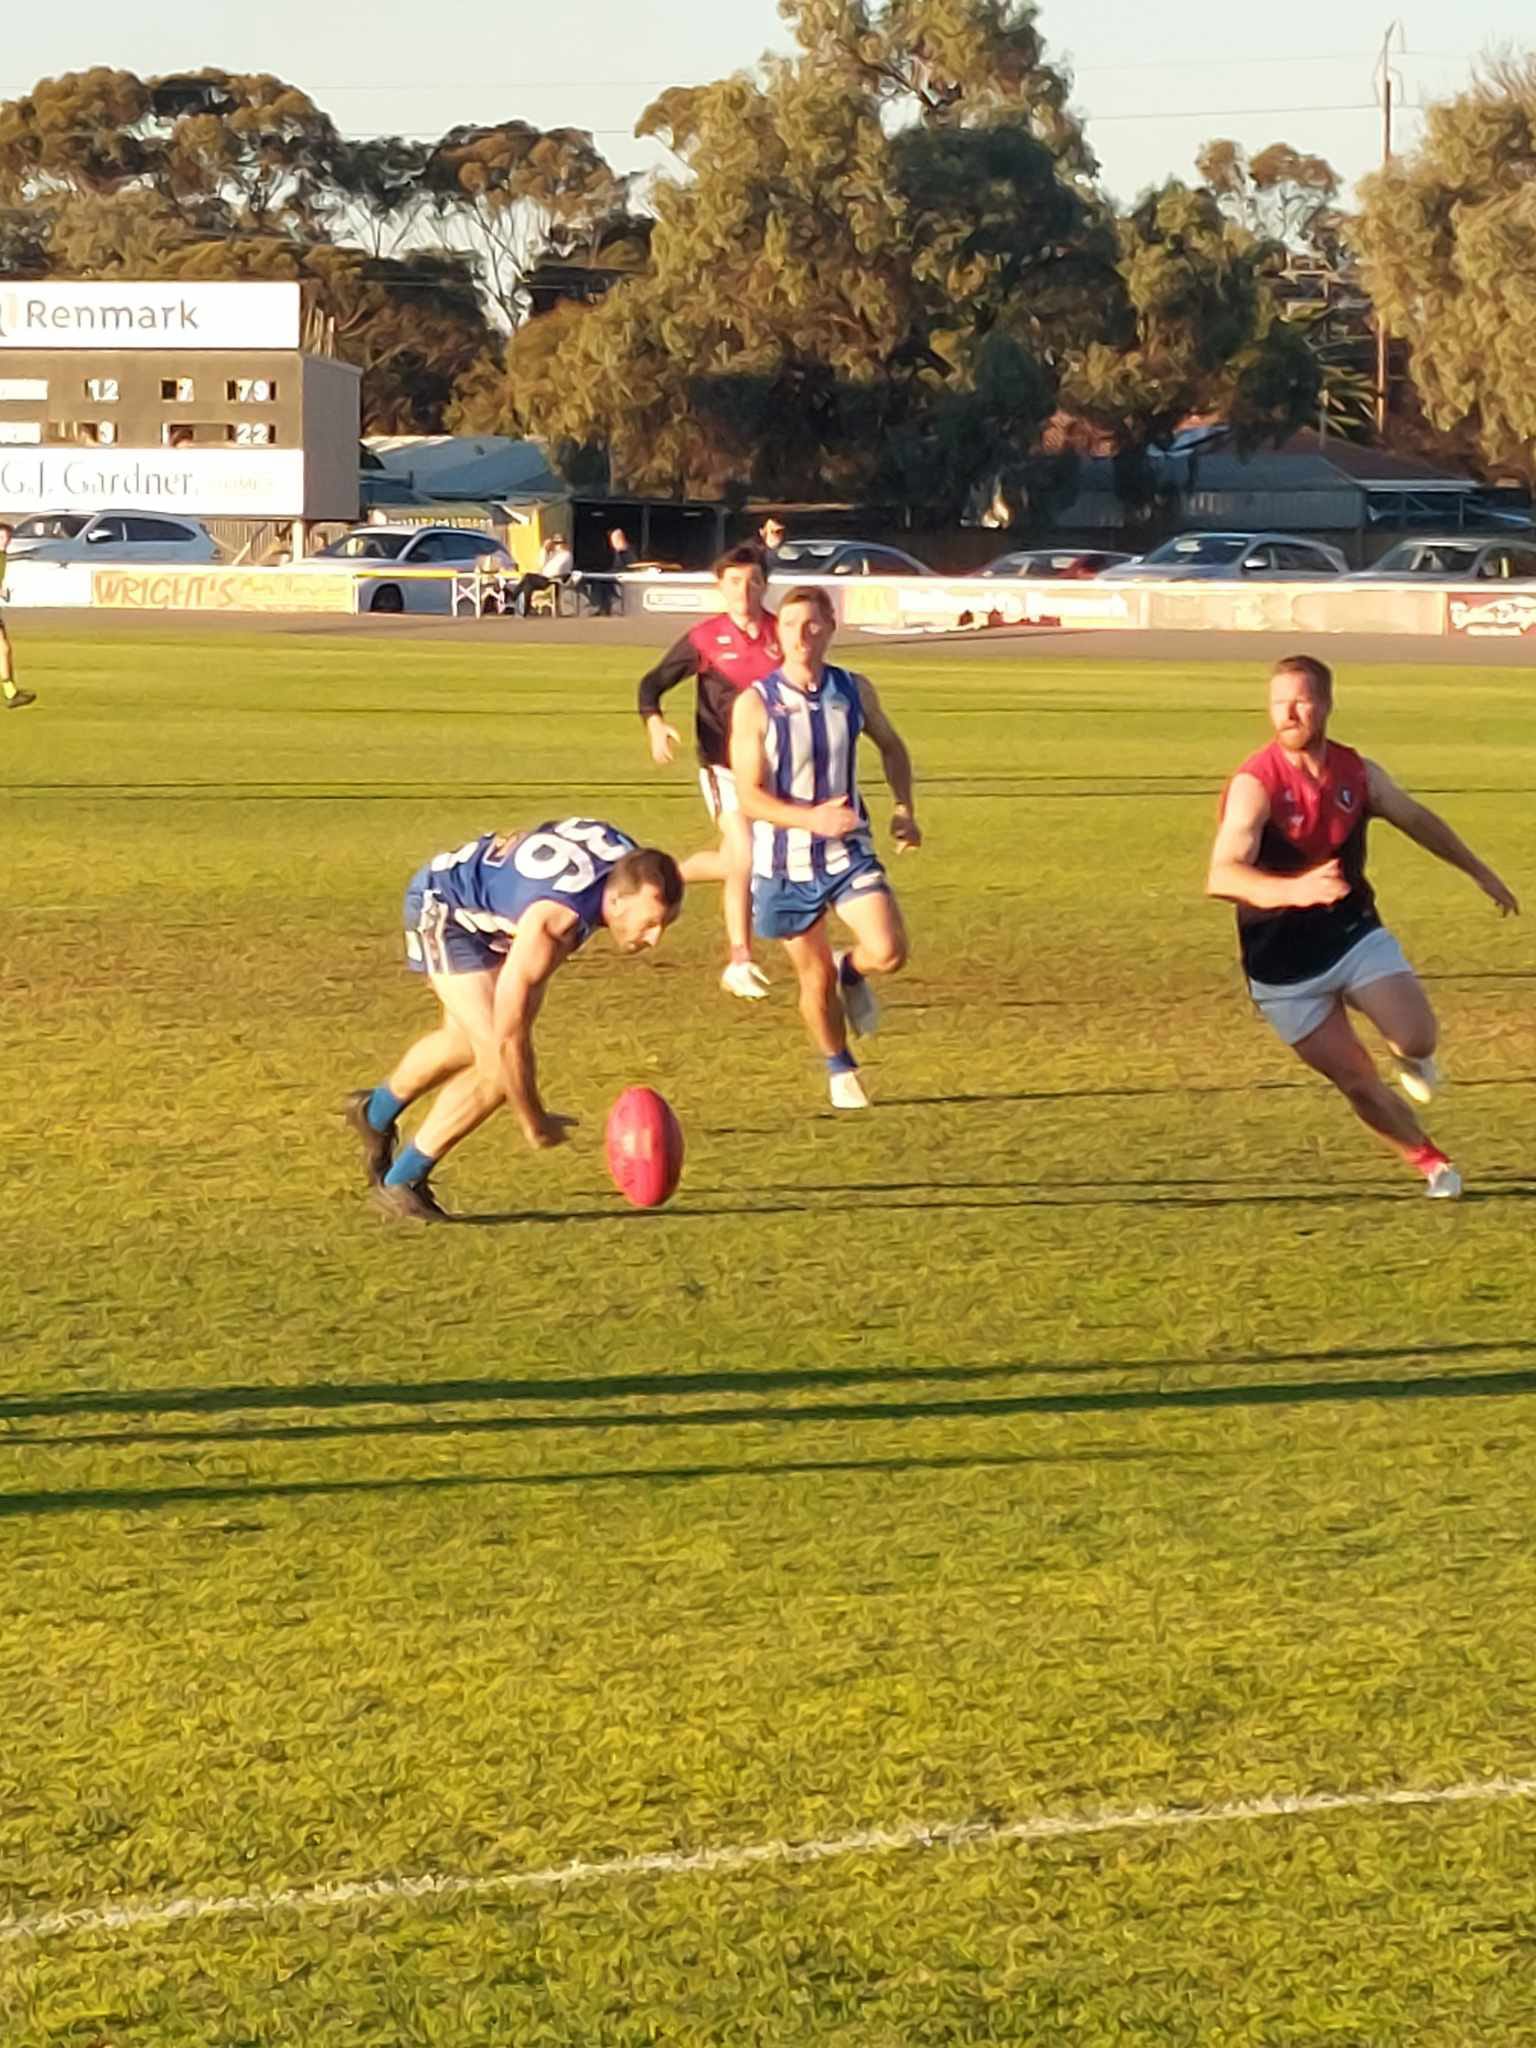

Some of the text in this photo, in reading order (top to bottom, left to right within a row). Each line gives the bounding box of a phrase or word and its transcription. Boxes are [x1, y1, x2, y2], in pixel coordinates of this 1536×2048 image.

[26, 299, 199, 329] Renmark
[88, 378, 269, 401] 12 7 79
[236, 422, 269, 444] 22
[95, 575, 237, 608] WRIGHT'S
